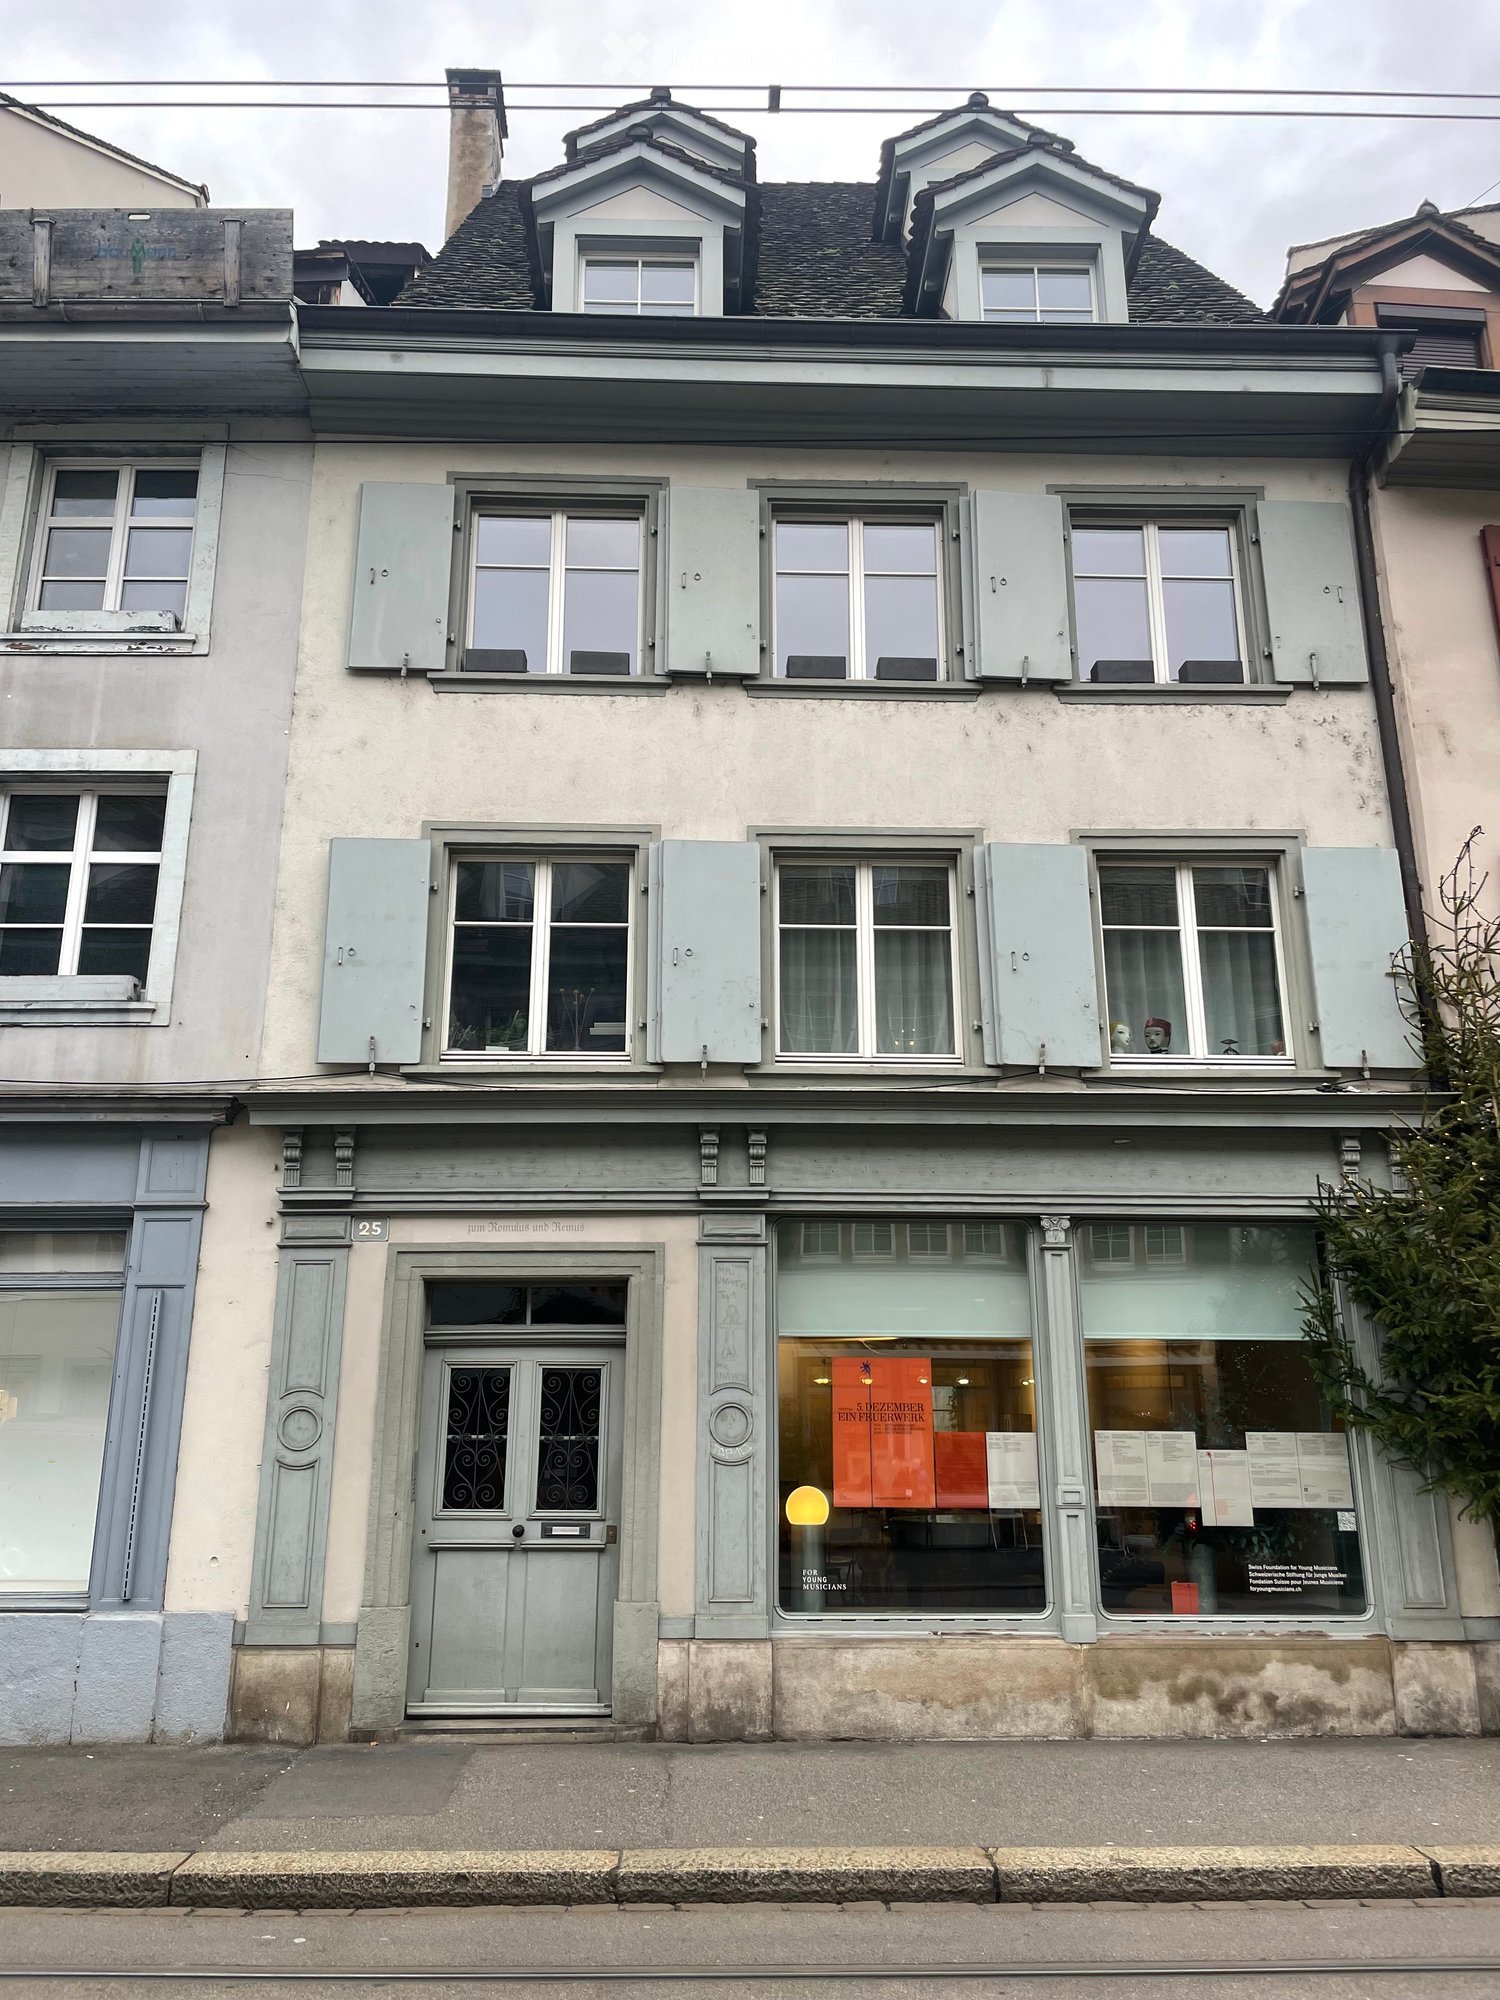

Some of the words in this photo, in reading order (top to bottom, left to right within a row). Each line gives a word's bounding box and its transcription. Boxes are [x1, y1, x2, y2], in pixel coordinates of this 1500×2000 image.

[358, 1222, 382, 1236] 25
[467, 1224, 485, 1235] zum
[488, 1221, 530, 1232] Romulus
[532, 1222, 549, 1232] und
[552, 1221, 585, 1232] Remus
[865, 1402, 924, 1412] DEZEMBER
[838, 1412, 857, 1421] EIN
